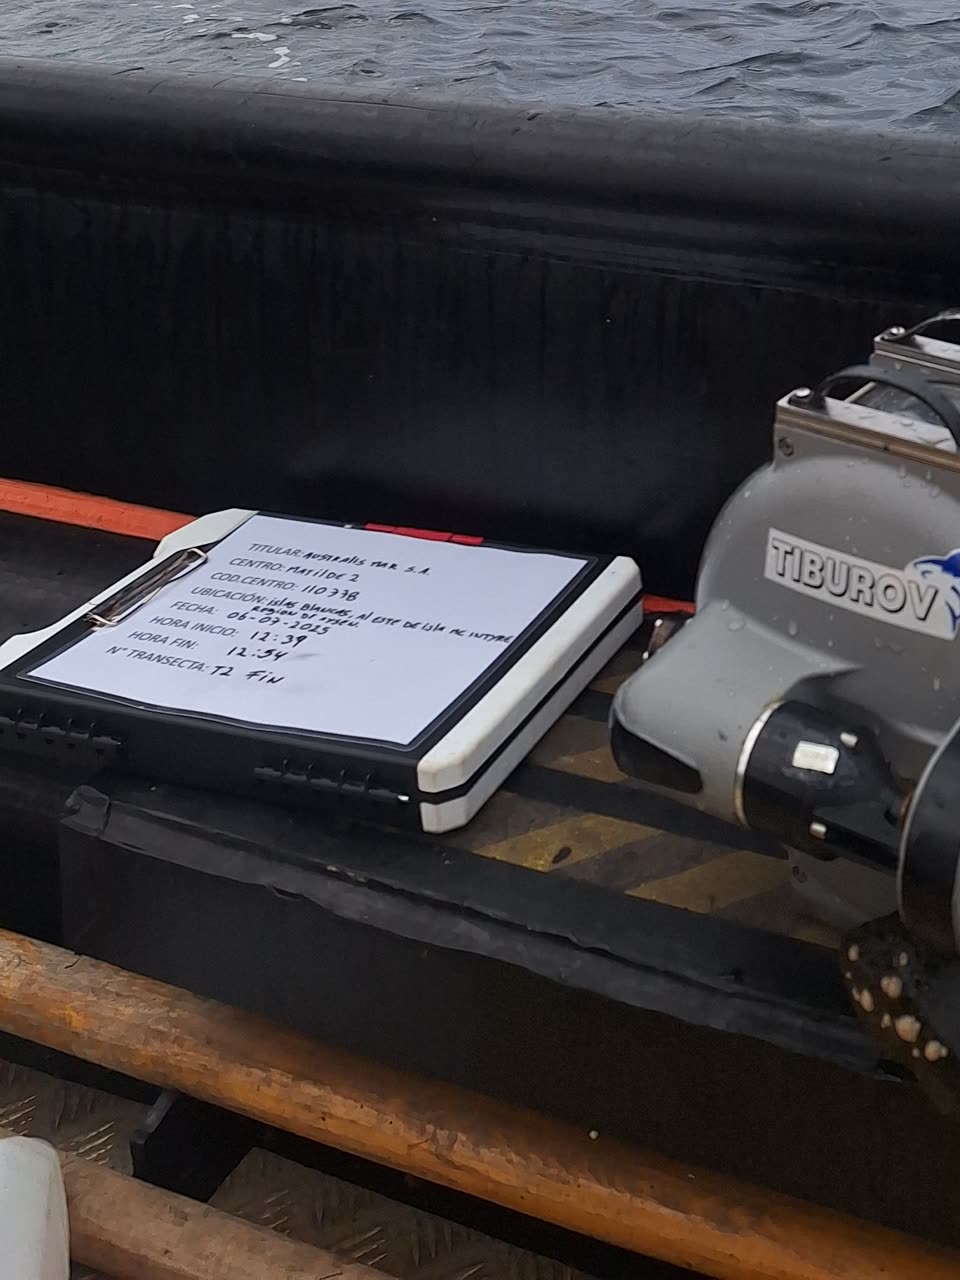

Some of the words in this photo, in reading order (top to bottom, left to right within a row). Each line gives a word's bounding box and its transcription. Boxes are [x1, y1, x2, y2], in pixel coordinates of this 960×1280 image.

[248, 543, 303, 558] TITULAR:
[210, 572, 298, 591] COD.CENTRO:
[229, 558, 286, 572] CENTRO:
[348, 573, 360, 583] 2
[772, 537, 939, 621] TIBUROV
[191, 586, 267, 604] UBICACIÓN:
[170, 601, 220, 616] FECHA:
[149, 616, 189, 630] HORA
[190, 622, 239, 637] INICIO:
[250, 631, 308, 649] 12:39
[128, 631, 172, 646] HORA
[169, 638, 200, 650] FIN:
[227, 646, 289, 661] 12:54
[127, 649, 210, 672] TRANSECTA:
[210, 665, 234, 677] T2
